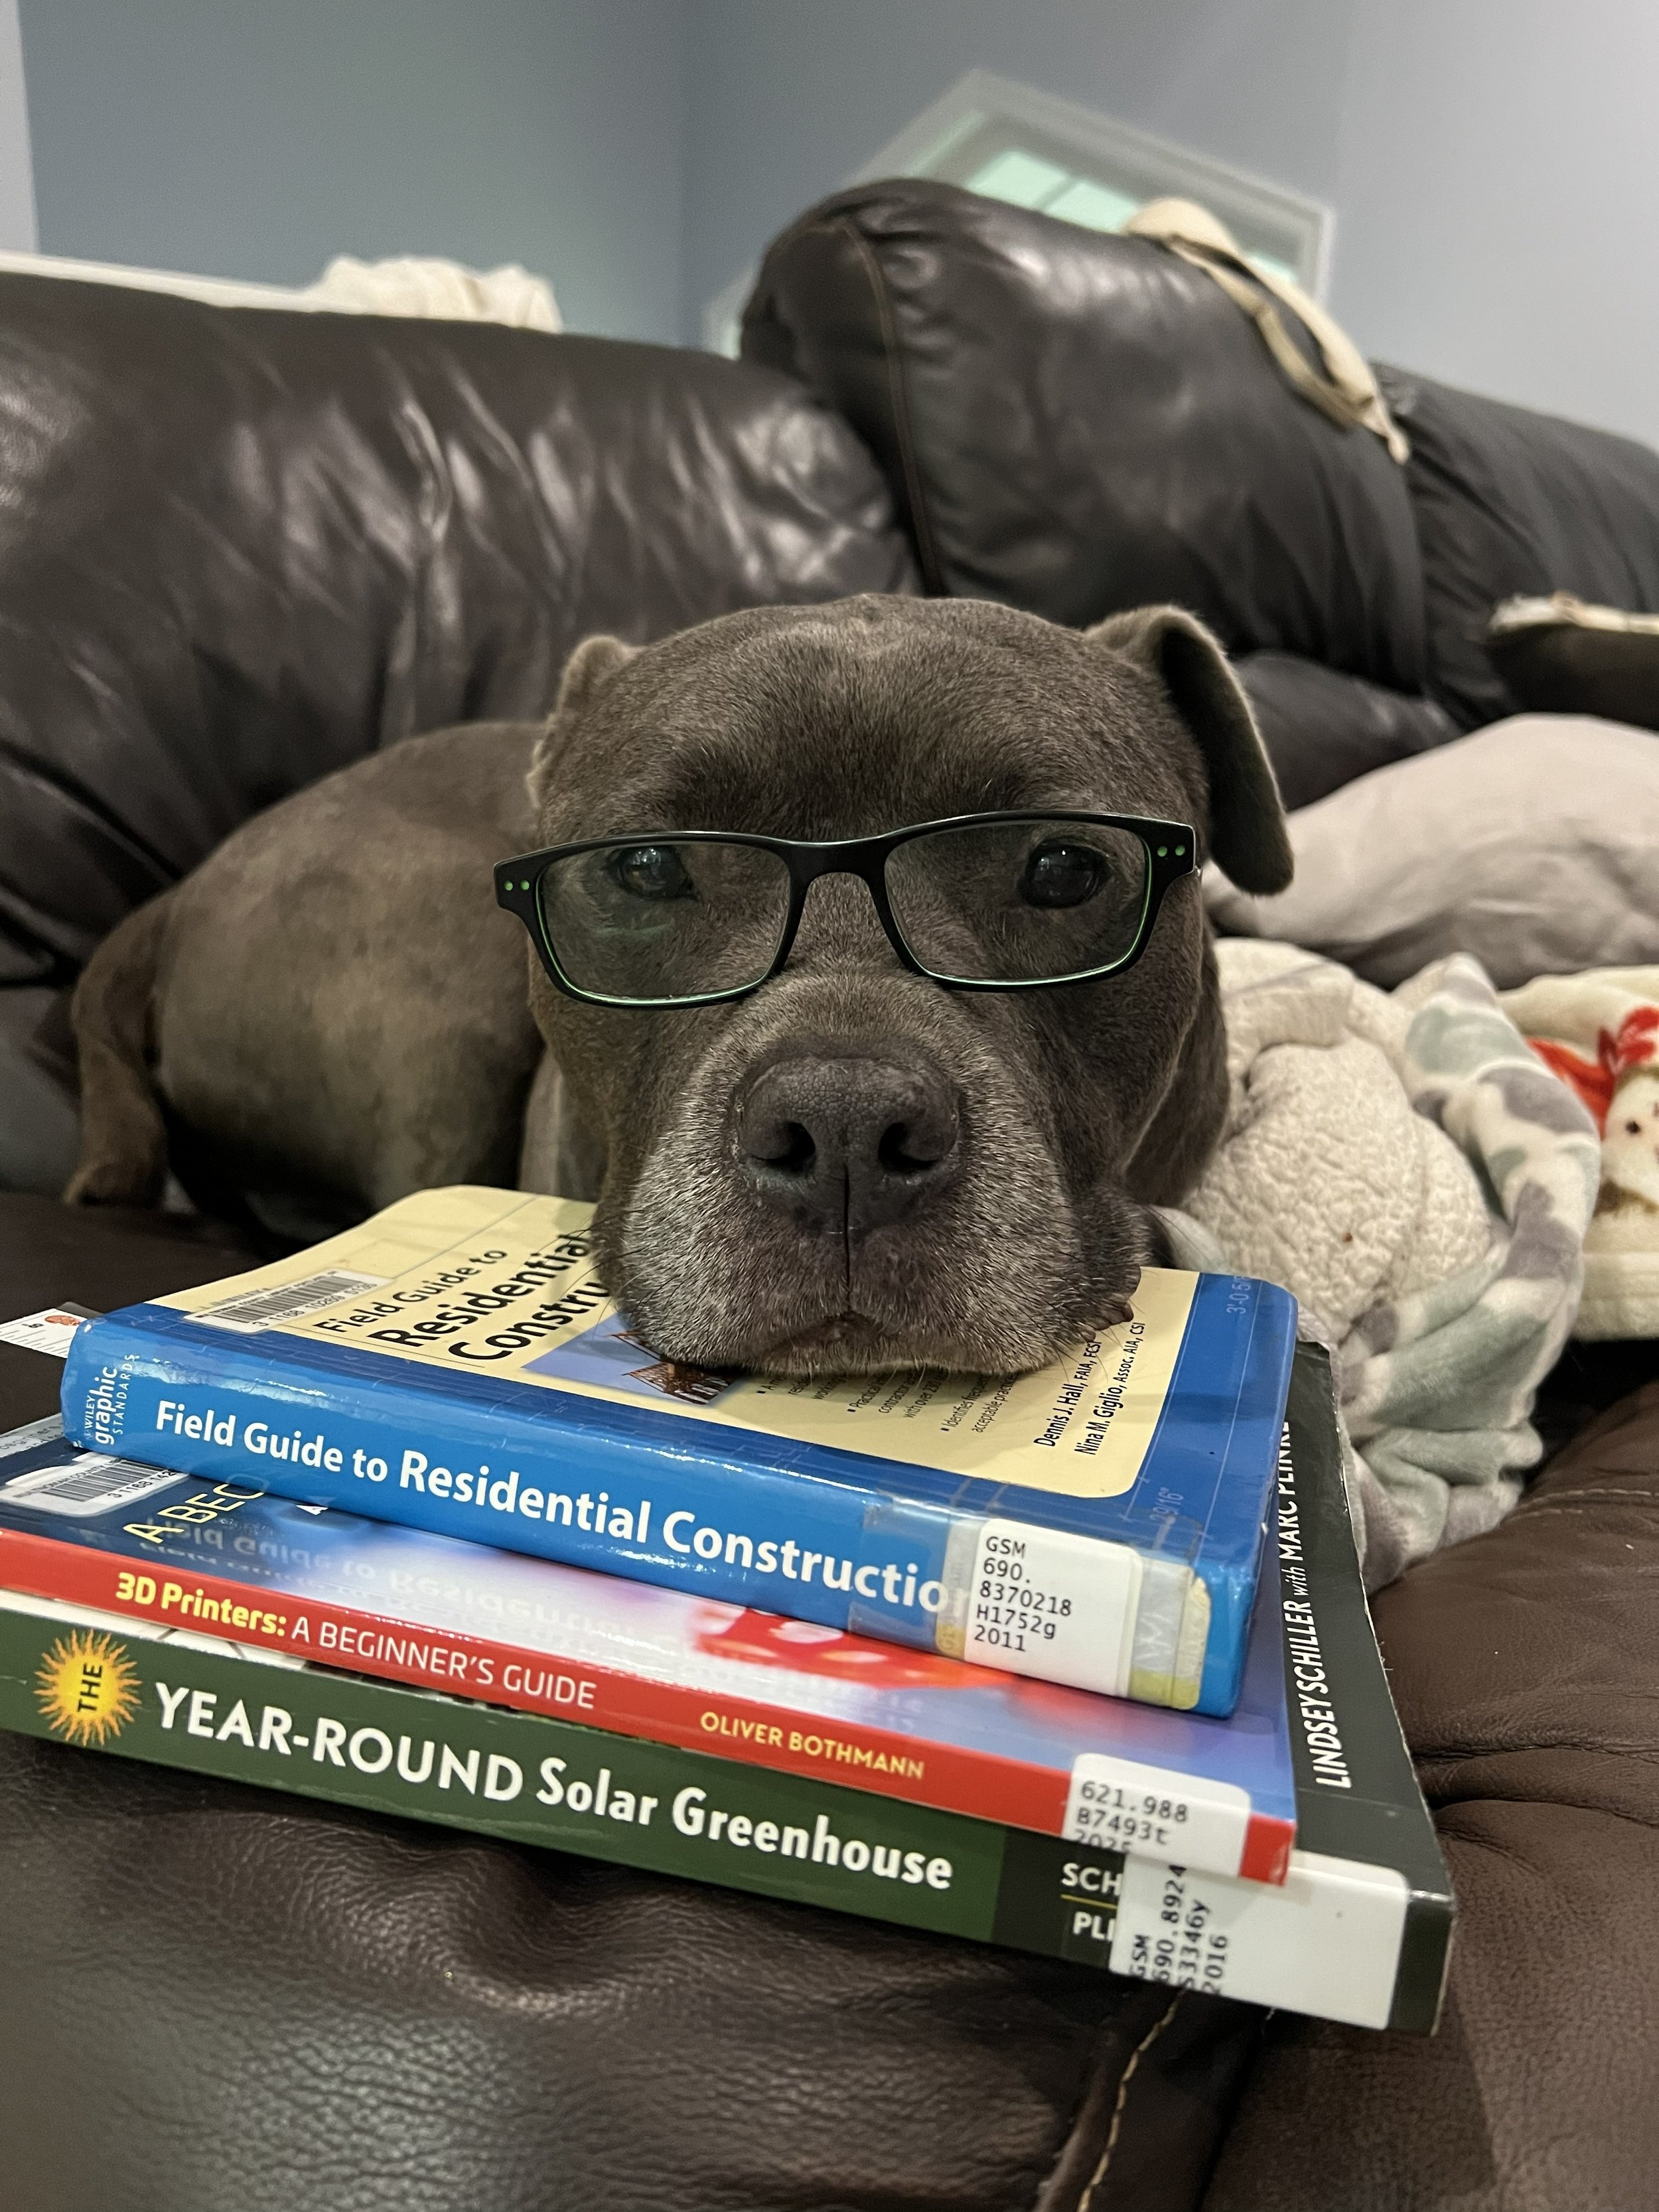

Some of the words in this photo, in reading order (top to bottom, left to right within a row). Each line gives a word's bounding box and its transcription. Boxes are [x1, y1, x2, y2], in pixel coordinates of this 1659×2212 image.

[313, 1301, 403, 1333] Field
[393, 1267, 481, 1303] Guide
[469, 1249, 508, 1266] to
[367, 1233, 591, 1347] Residential
[1129, 1322, 1145, 1335] CSI
[1083, 1341, 1102, 1358] FCSI
[1123, 1337, 1144, 1355] AIA,
[1074, 1361, 1098, 1380] FAIA,
[1113, 1356, 1134, 1383] Assoc.
[89, 1366, 117, 1445] graphic
[113, 1354, 135, 1434] STANDARDS
[1057, 1383, 1088, 1405] Hall,
[1093, 1384, 1127, 1418] Giglio,
[85, 1395, 96, 1429] WILEY
[972, 1401, 1003, 1433] acceptable
[1086, 1420, 1111, 1433] M.
[1033, 1415, 1070, 1447] Dennis
[1074, 1433, 1104, 1455] Nina
[121, 1481, 153, 1495] 1168
[155, 1400, 236, 1447] Field
[244, 1422, 342, 1473] Guide
[352, 1449, 388, 1482] to
[399, 1449, 651, 1543] Residential
[123, 1523, 184, 1544] A
[985, 1535, 1025, 1558] GSM
[1277, 1501, 1304, 1561] MARC
[983, 1557, 1031, 1584] 690.
[1281, 1566, 1309, 1595] with
[979, 1580, 1072, 1617] 8370218
[976, 1603, 1056, 1640] H1752g
[974, 1625, 1027, 1653] 2011
[1283, 1600, 1329, 1694] SCHILLER
[115, 1572, 157, 1606] 3D
[161, 1585, 287, 1637] Printers:
[291, 1616, 311, 1643] A
[319, 1620, 495, 1685] BEGINNER'S
[502, 1664, 597, 1710] GUIDE
[700, 1712, 783, 1747] OLIVER
[788, 1731, 926, 1780] BOTHMANN
[1298, 1693, 1352, 1789] LINDSEY
[78, 1661, 103, 1713] THE
[155, 1682, 524, 1803] YEAR-ROUND
[536, 1757, 658, 1826] Solar
[672, 1787, 954, 1890] Greenhouse
[1081, 1780, 1189, 1823] 621.988
[1062, 1862, 1124, 1897] SCH
